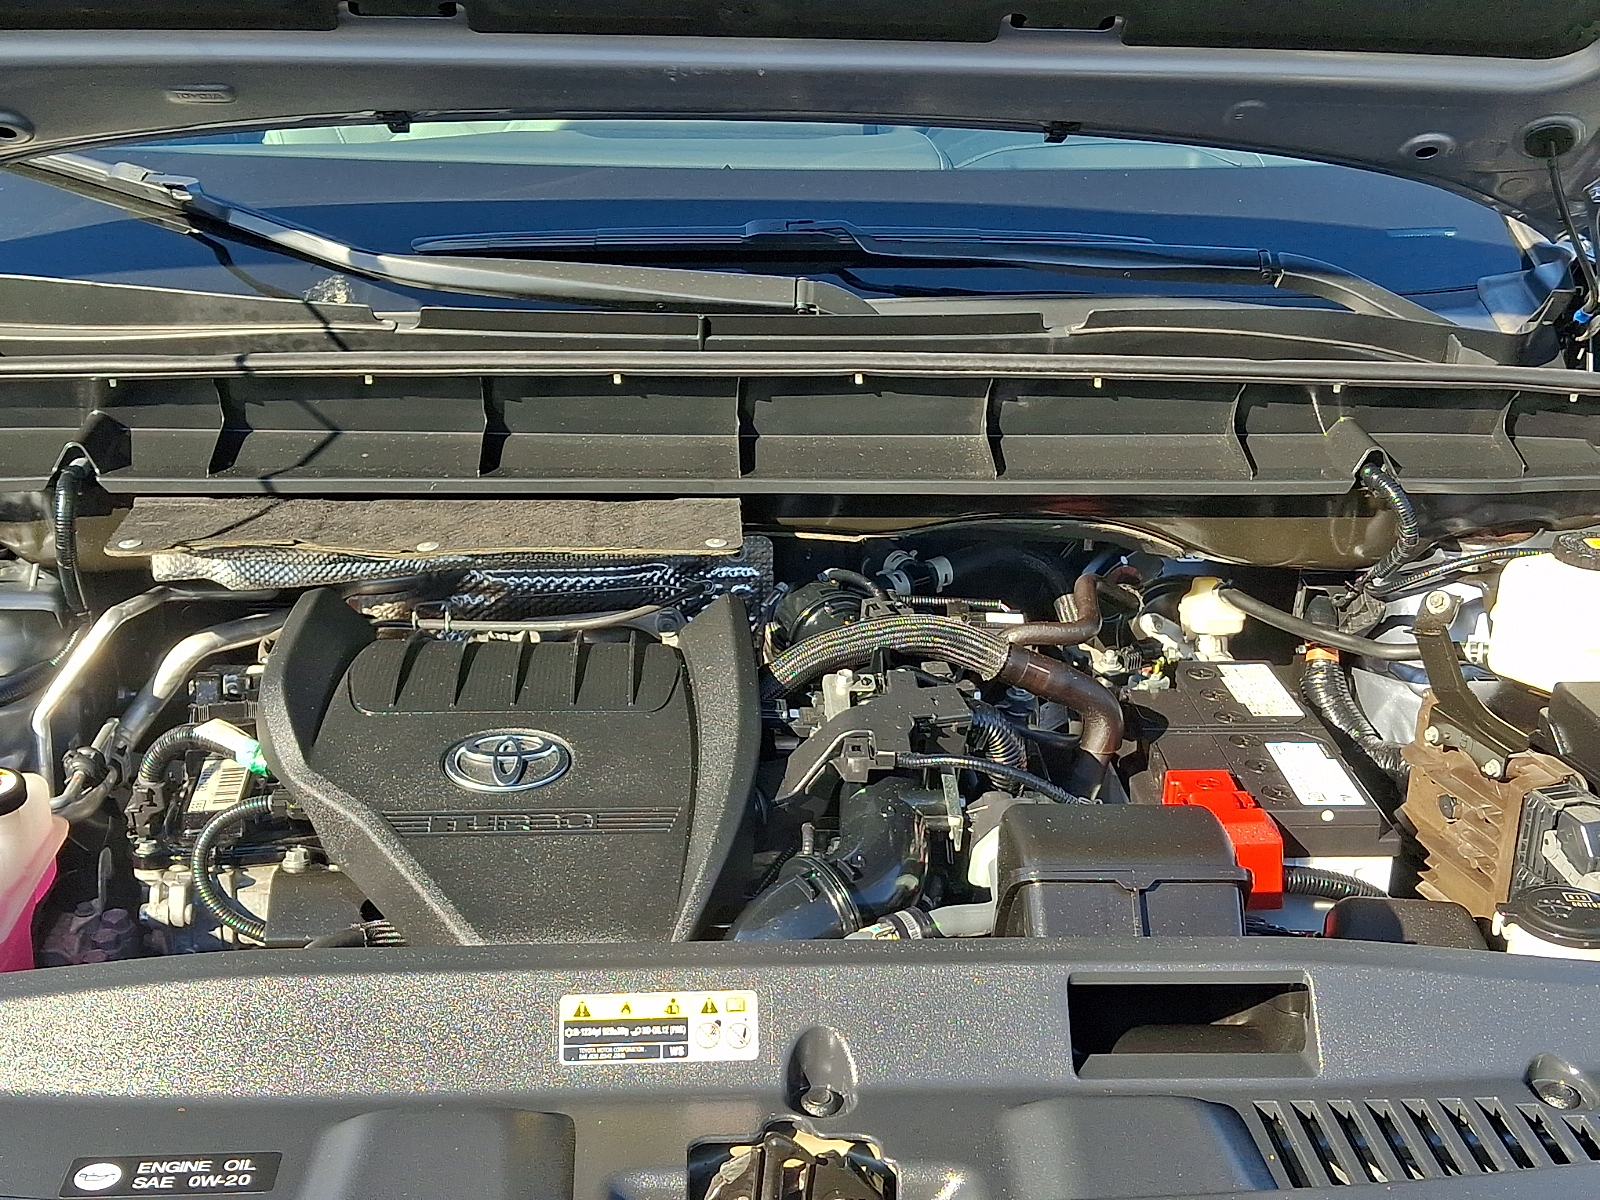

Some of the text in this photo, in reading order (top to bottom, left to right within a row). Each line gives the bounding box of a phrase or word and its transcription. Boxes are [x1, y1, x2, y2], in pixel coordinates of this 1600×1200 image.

[431, 813, 594, 831] TURBO
[136, 1158, 257, 1174] ENGINE OIL
[131, 1174, 252, 1189] SAE 0W-20
